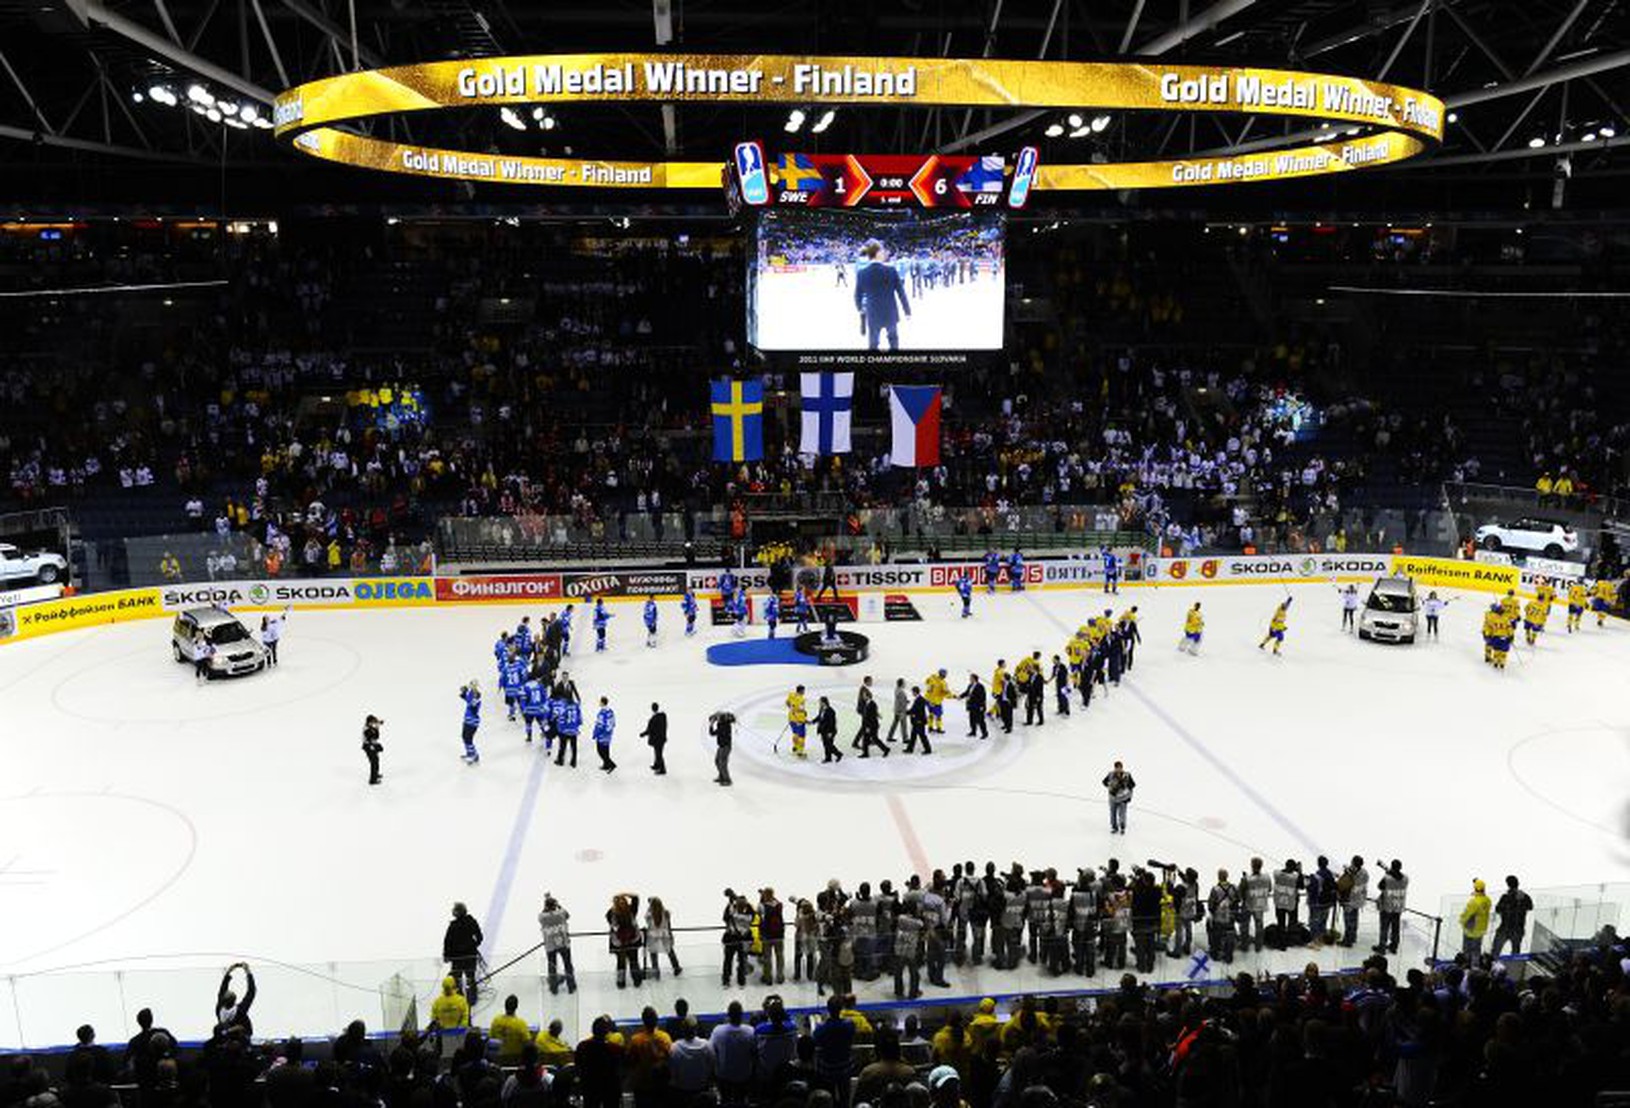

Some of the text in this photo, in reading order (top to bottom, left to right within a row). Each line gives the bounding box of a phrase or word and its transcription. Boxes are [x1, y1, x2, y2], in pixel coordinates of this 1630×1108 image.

[458, 68, 526, 97] Gold
[533, 64, 634, 95] Medal
[643, 63, 763, 95] Winner
[793, 66, 915, 97] Finland
[1160, 73, 1228, 103] Gold
[1236, 75, 1317, 109] Medal
[1324, 85, 1392, 118] Winner
[403, 151, 439, 171] Gold
[443, 155, 495, 176] Medal
[500, 159, 565, 182] Winner
[582, 165, 651, 183] Finland
[1172, 163, 1213, 182] Gold
[1217, 159, 1272, 179] Medal
[1276, 154, 1331, 175] Winner
[1342, 143, 1390, 165] Finland
[834, 177, 948, 194] 1 0:00 6
[779, 191, 808, 203] SWE
[974, 193, 998, 205] FIN
[837, 355, 866, 364] WORLD
[851, 571, 924, 586] TISSOT
[1407, 562, 1514, 584] Raiffeisen BANK
[566, 575, 621, 598] ОХОТА
[117, 596, 156, 610] БАНК
